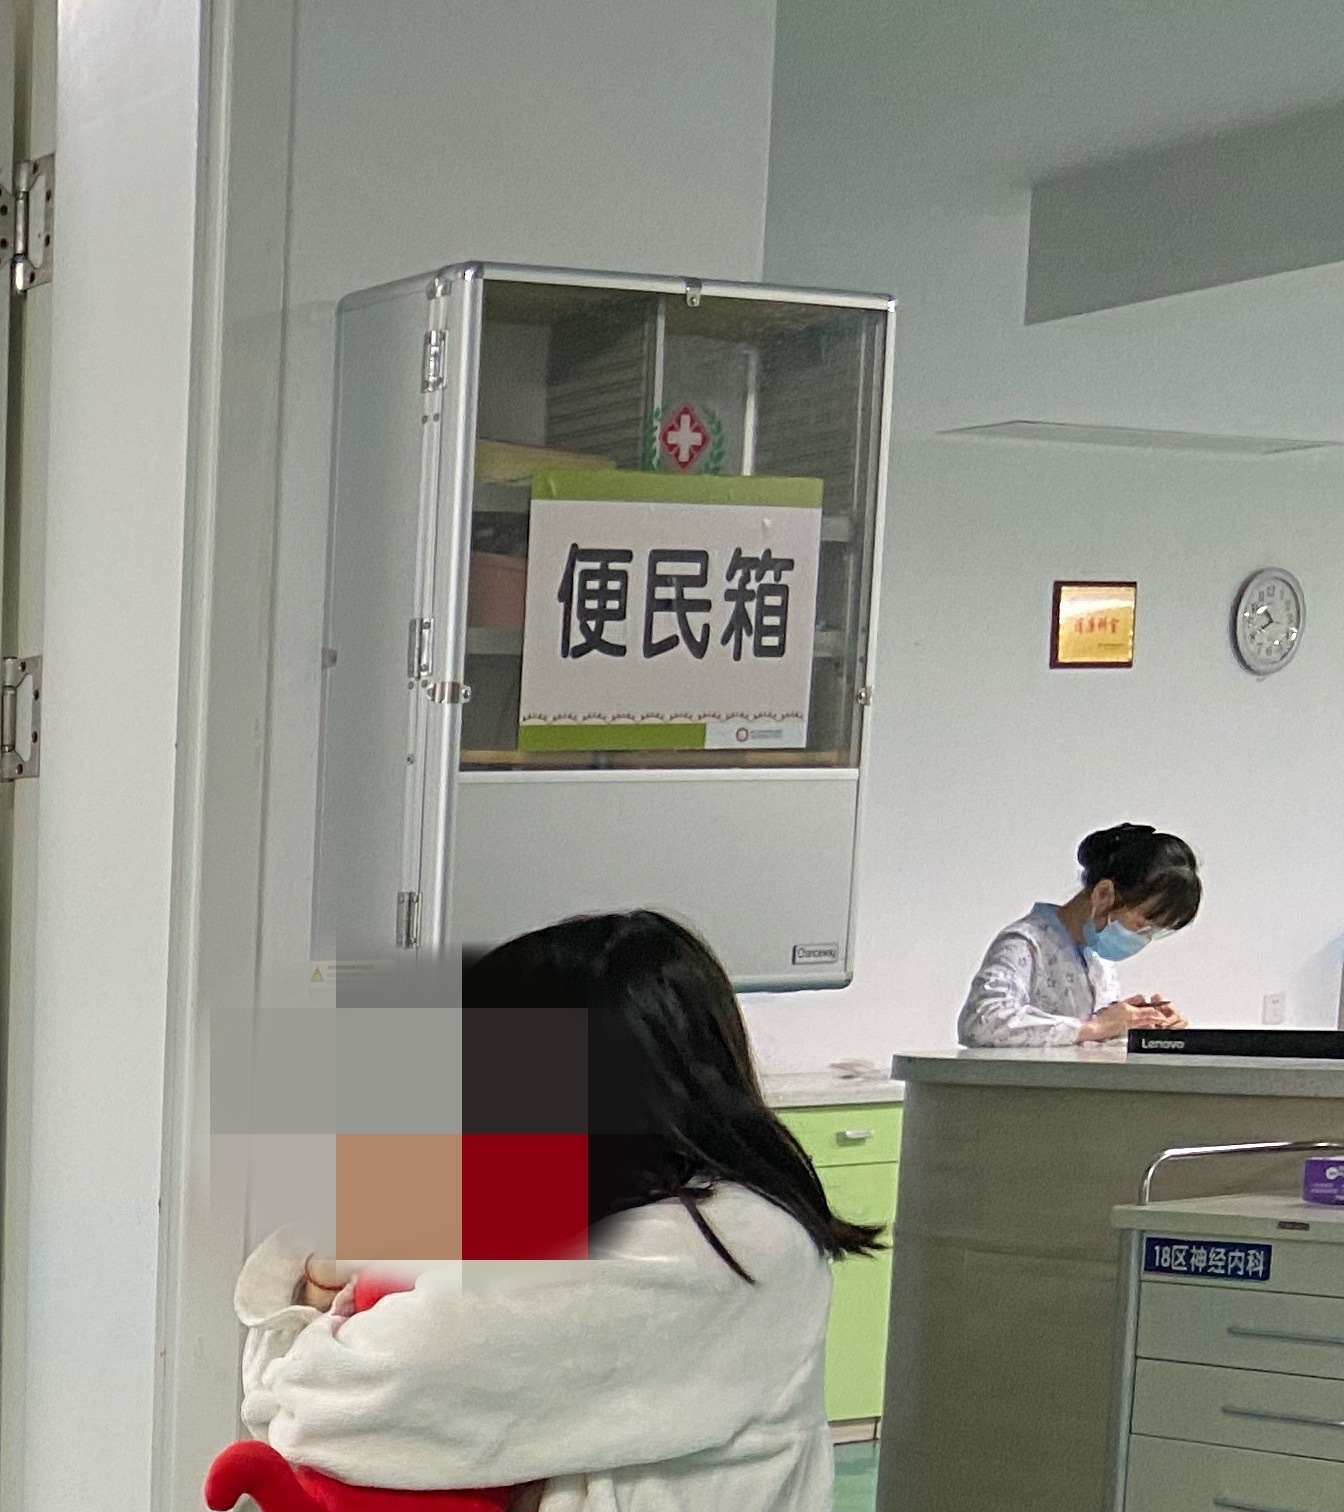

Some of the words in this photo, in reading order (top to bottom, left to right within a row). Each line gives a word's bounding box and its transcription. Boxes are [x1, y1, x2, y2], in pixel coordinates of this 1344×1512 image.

[556, 543, 796, 662] 便民箱
[1141, 1038, 1185, 1050] Lenovo
[1154, 1244, 1265, 1278] 18区神经内科
